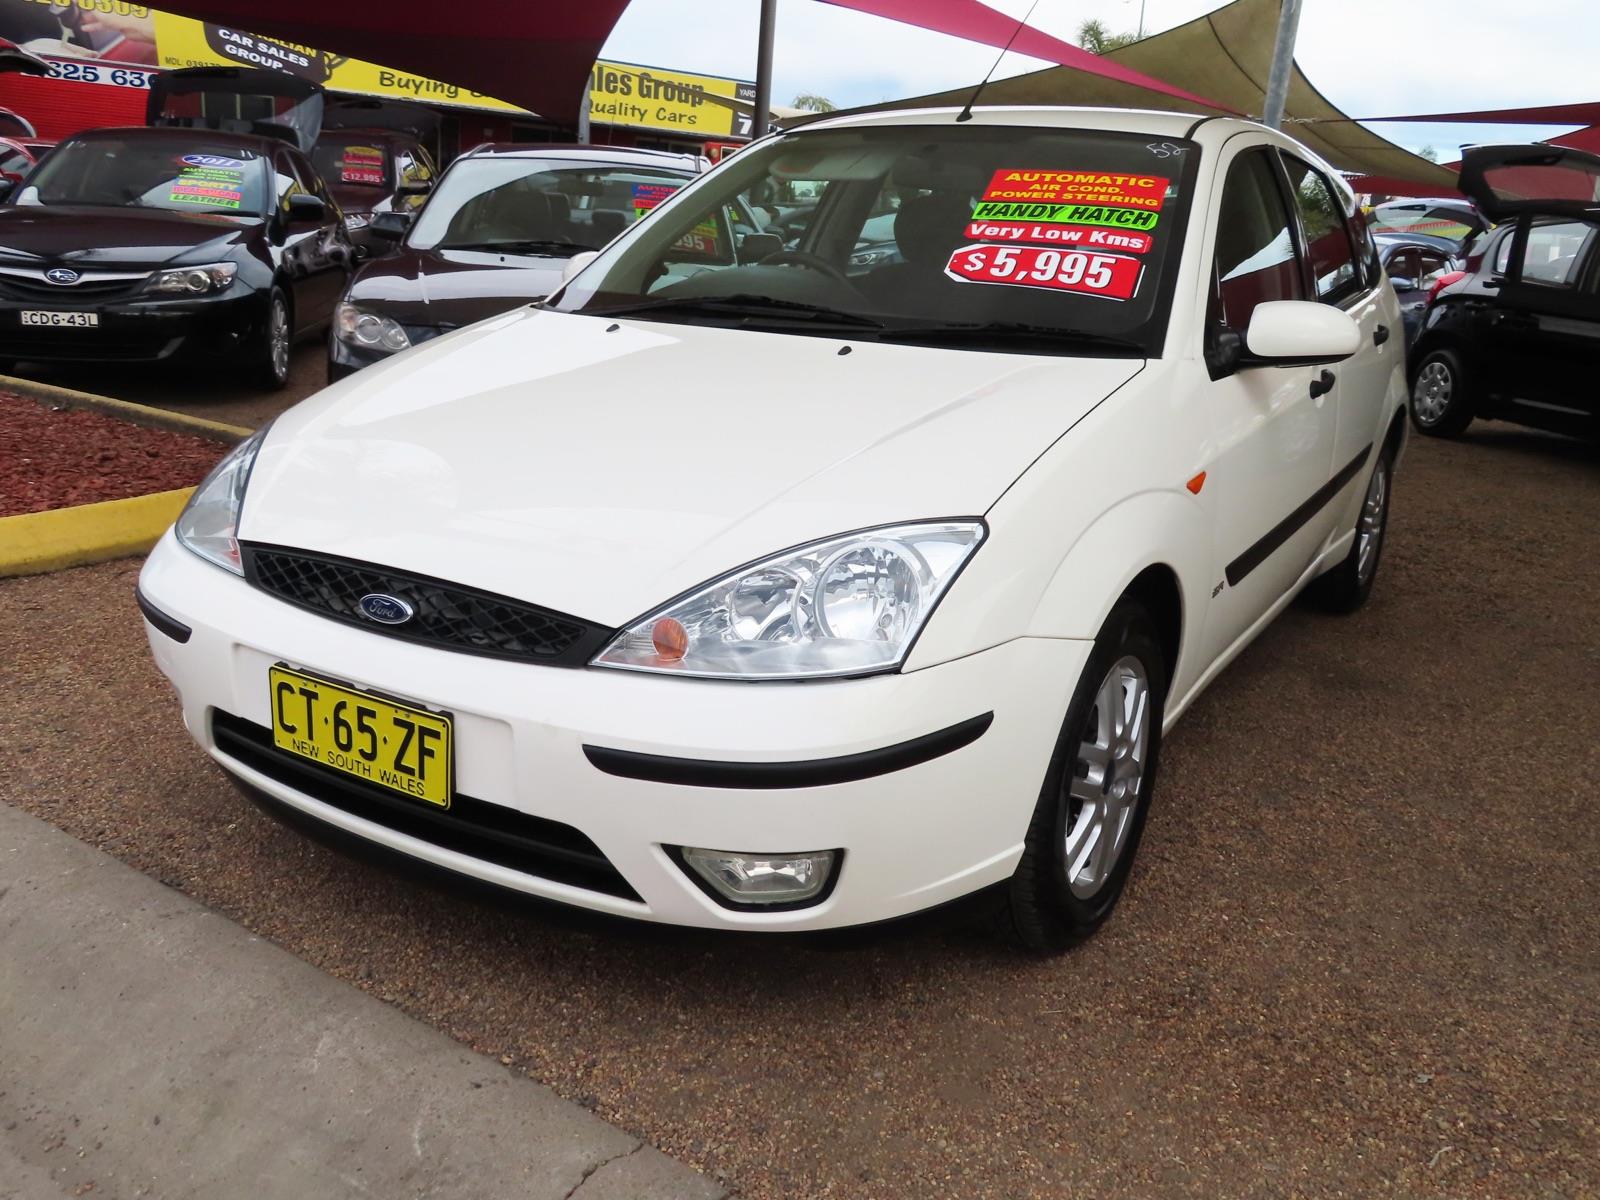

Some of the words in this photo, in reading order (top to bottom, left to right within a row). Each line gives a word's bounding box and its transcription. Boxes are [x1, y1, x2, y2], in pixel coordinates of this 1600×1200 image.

[218, 29, 253, 48] CAR
[257, 41, 310, 67] SALES
[224, 44, 283, 70] GROUP
[111, 70, 151, 88] 63
[379, 71, 459, 98] Buying
[638, 72, 704, 107] Group
[739, 88, 757, 98] YARD
[656, 107, 697, 125] Cars
[189, 156, 236, 166] 2011
[183, 167, 240, 176] AUTOMATIC
[1004, 171, 1156, 188] AUTOMATIC
[1029, 183, 1064, 192] AIR
[1067, 184, 1125, 195] COND.
[174, 194, 236, 206] LEATHER
[989, 190, 1057, 201] POWER
[1061, 192, 1159, 207] STEERING
[976, 203, 1064, 220] HANDY
[1067, 205, 1155, 227] HATCH
[970, 223, 1026, 240] Very
[1030, 226, 1083, 242] Low
[1088, 231, 1145, 249] Kms
[369, 599, 397, 618] Ford
[292, 738, 320, 758] NEW
[327, 750, 371, 777] SOUTH
[379, 768, 425, 796] WALES
